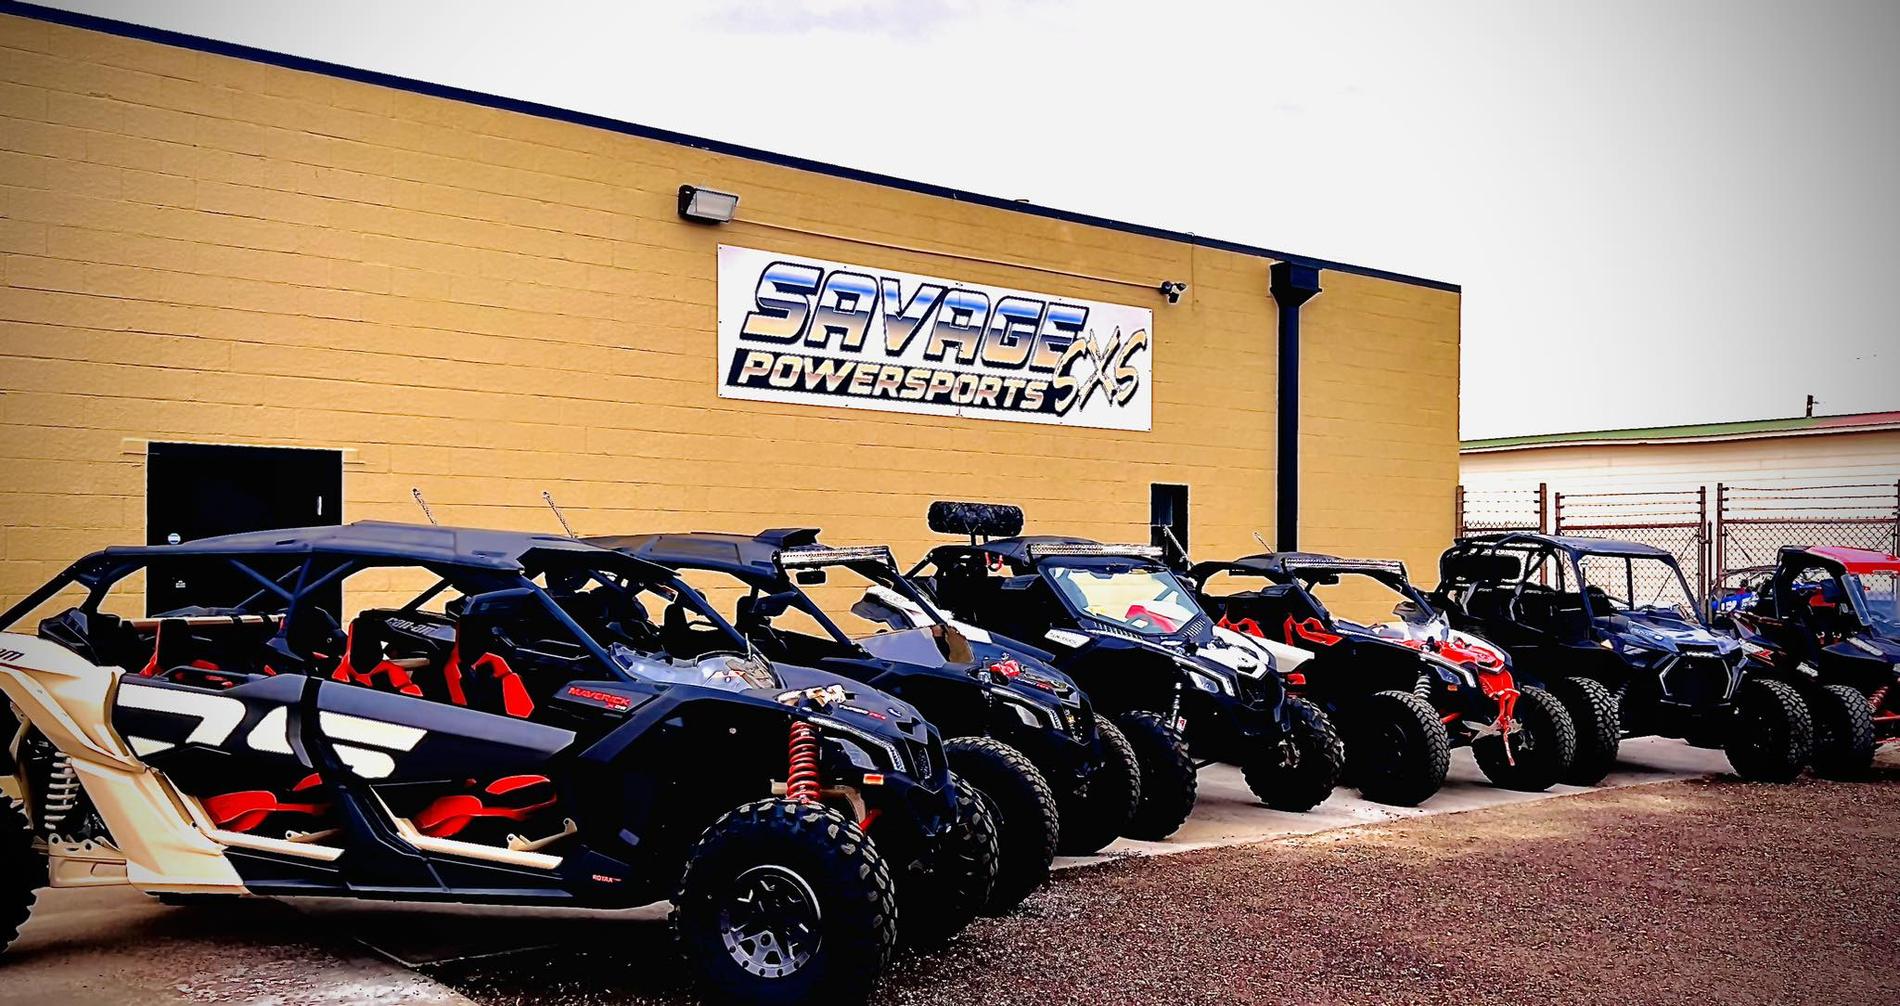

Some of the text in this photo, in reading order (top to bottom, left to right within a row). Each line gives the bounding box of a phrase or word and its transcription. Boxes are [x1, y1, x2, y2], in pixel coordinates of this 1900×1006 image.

[740, 261, 1090, 372] SAVAGE
[738, 354, 1048, 409] POWERSPORTS
[567, 686, 632, 706] MAVERICK
